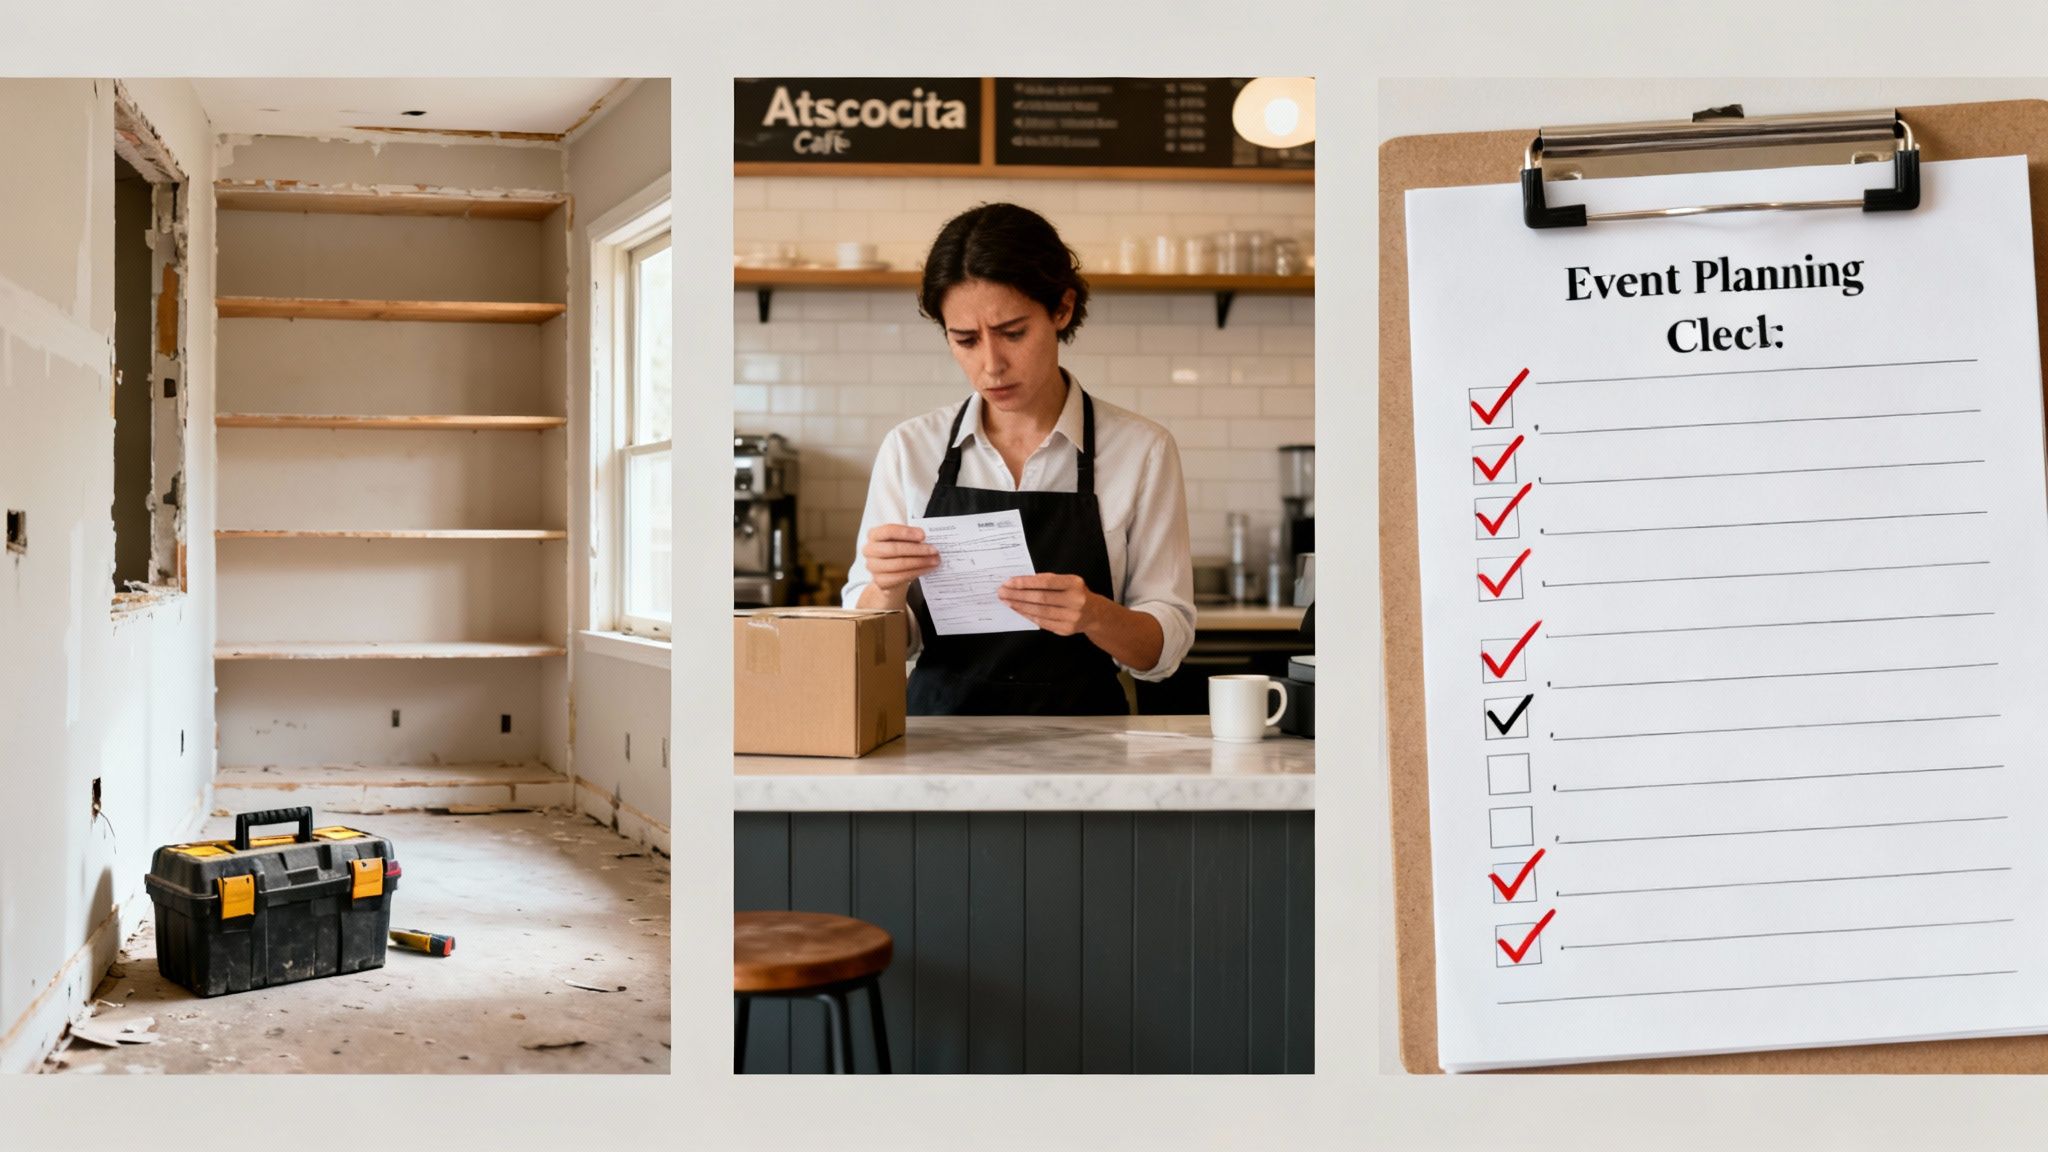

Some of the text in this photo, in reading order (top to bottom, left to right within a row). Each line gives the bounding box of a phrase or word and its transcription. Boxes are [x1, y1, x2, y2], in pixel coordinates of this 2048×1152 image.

[762, 86, 967, 129] Atscocita
[1565, 253, 1865, 301] Event Planning
